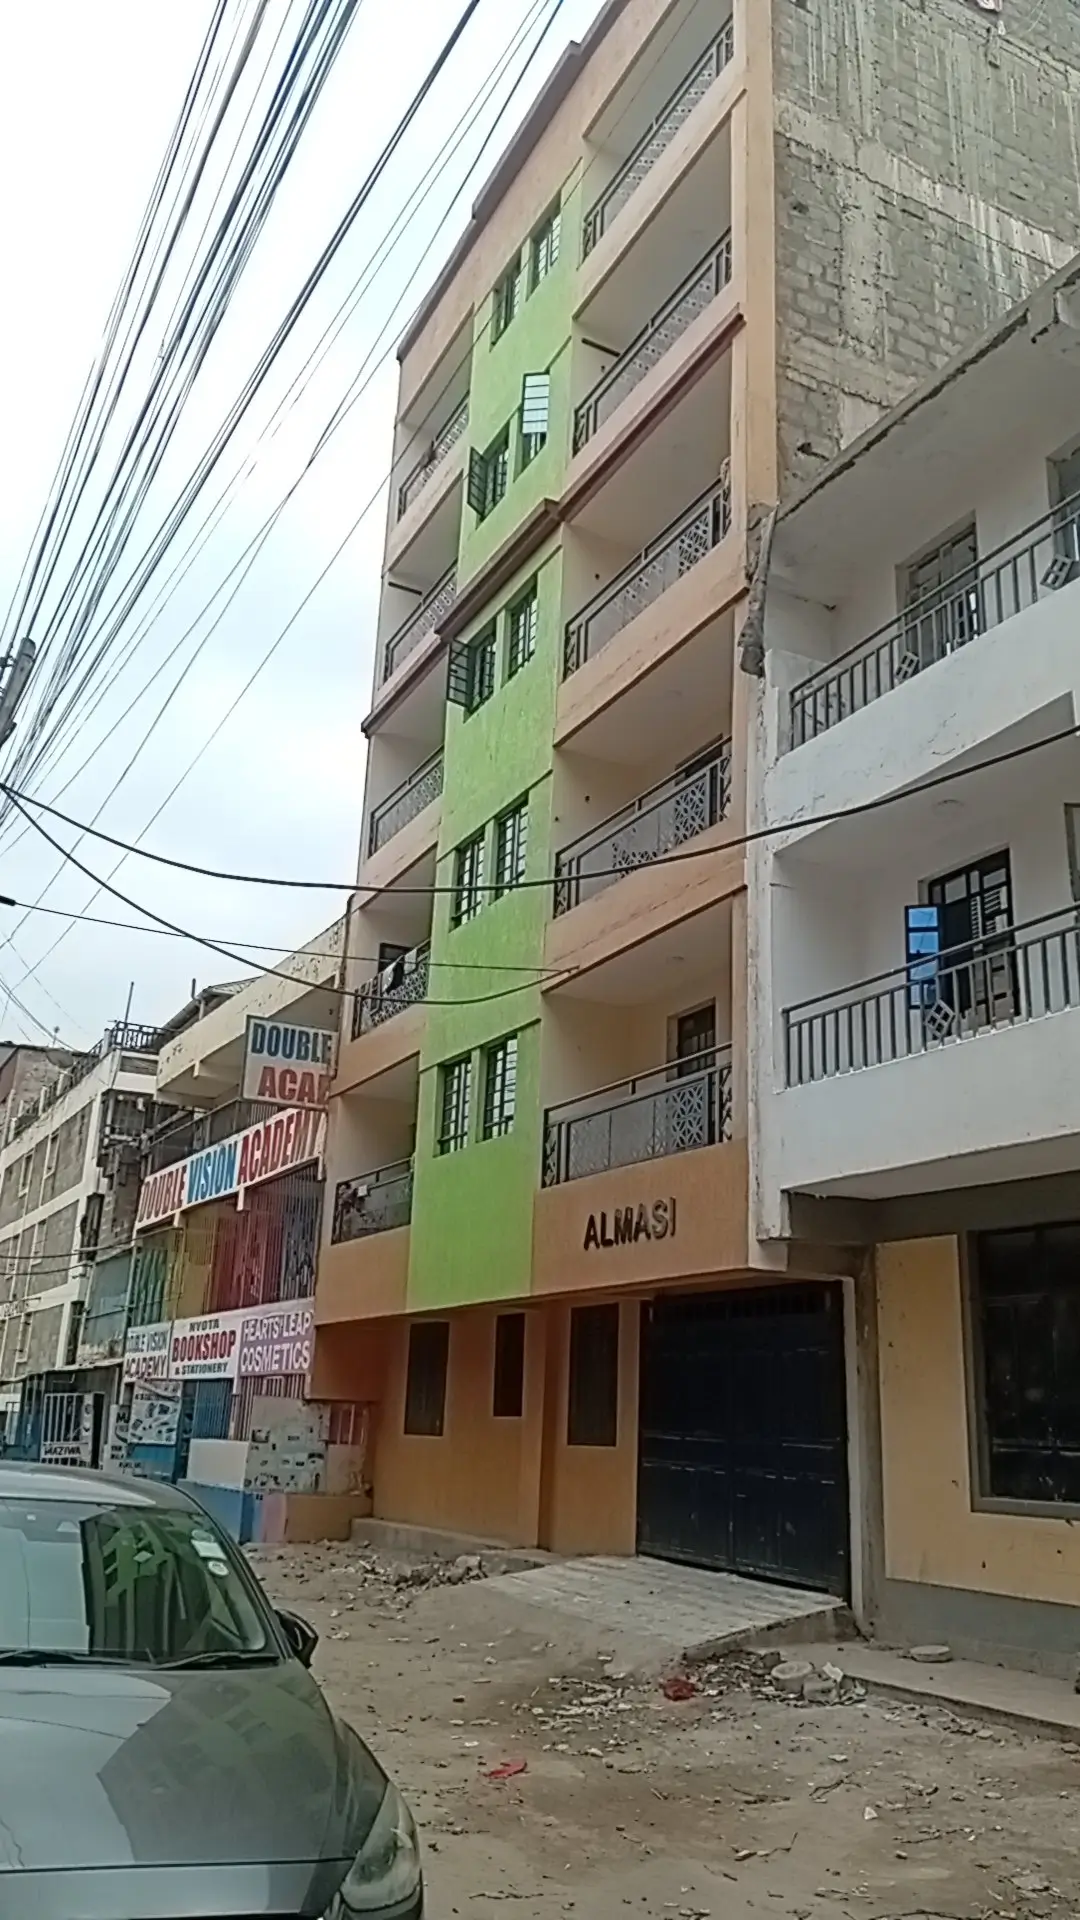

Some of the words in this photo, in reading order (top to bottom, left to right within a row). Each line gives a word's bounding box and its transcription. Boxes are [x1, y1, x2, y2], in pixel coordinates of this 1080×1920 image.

[251, 1022, 332, 1064] DOUBLE
[137, 1164, 188, 1224] DOUBLE
[186, 1140, 238, 1205] VISION
[236, 1110, 322, 1187] ACADEMY
[583, 1196, 677, 1251] ALMASI
[189, 1318, 220, 1333] NYOTA
[282, 1312, 312, 1338] LEAP
[171, 1329, 237, 1362] BOOKSHOP
[240, 1340, 311, 1373] COSMETICS
[181, 1361, 229, 1376] STATIONERY
